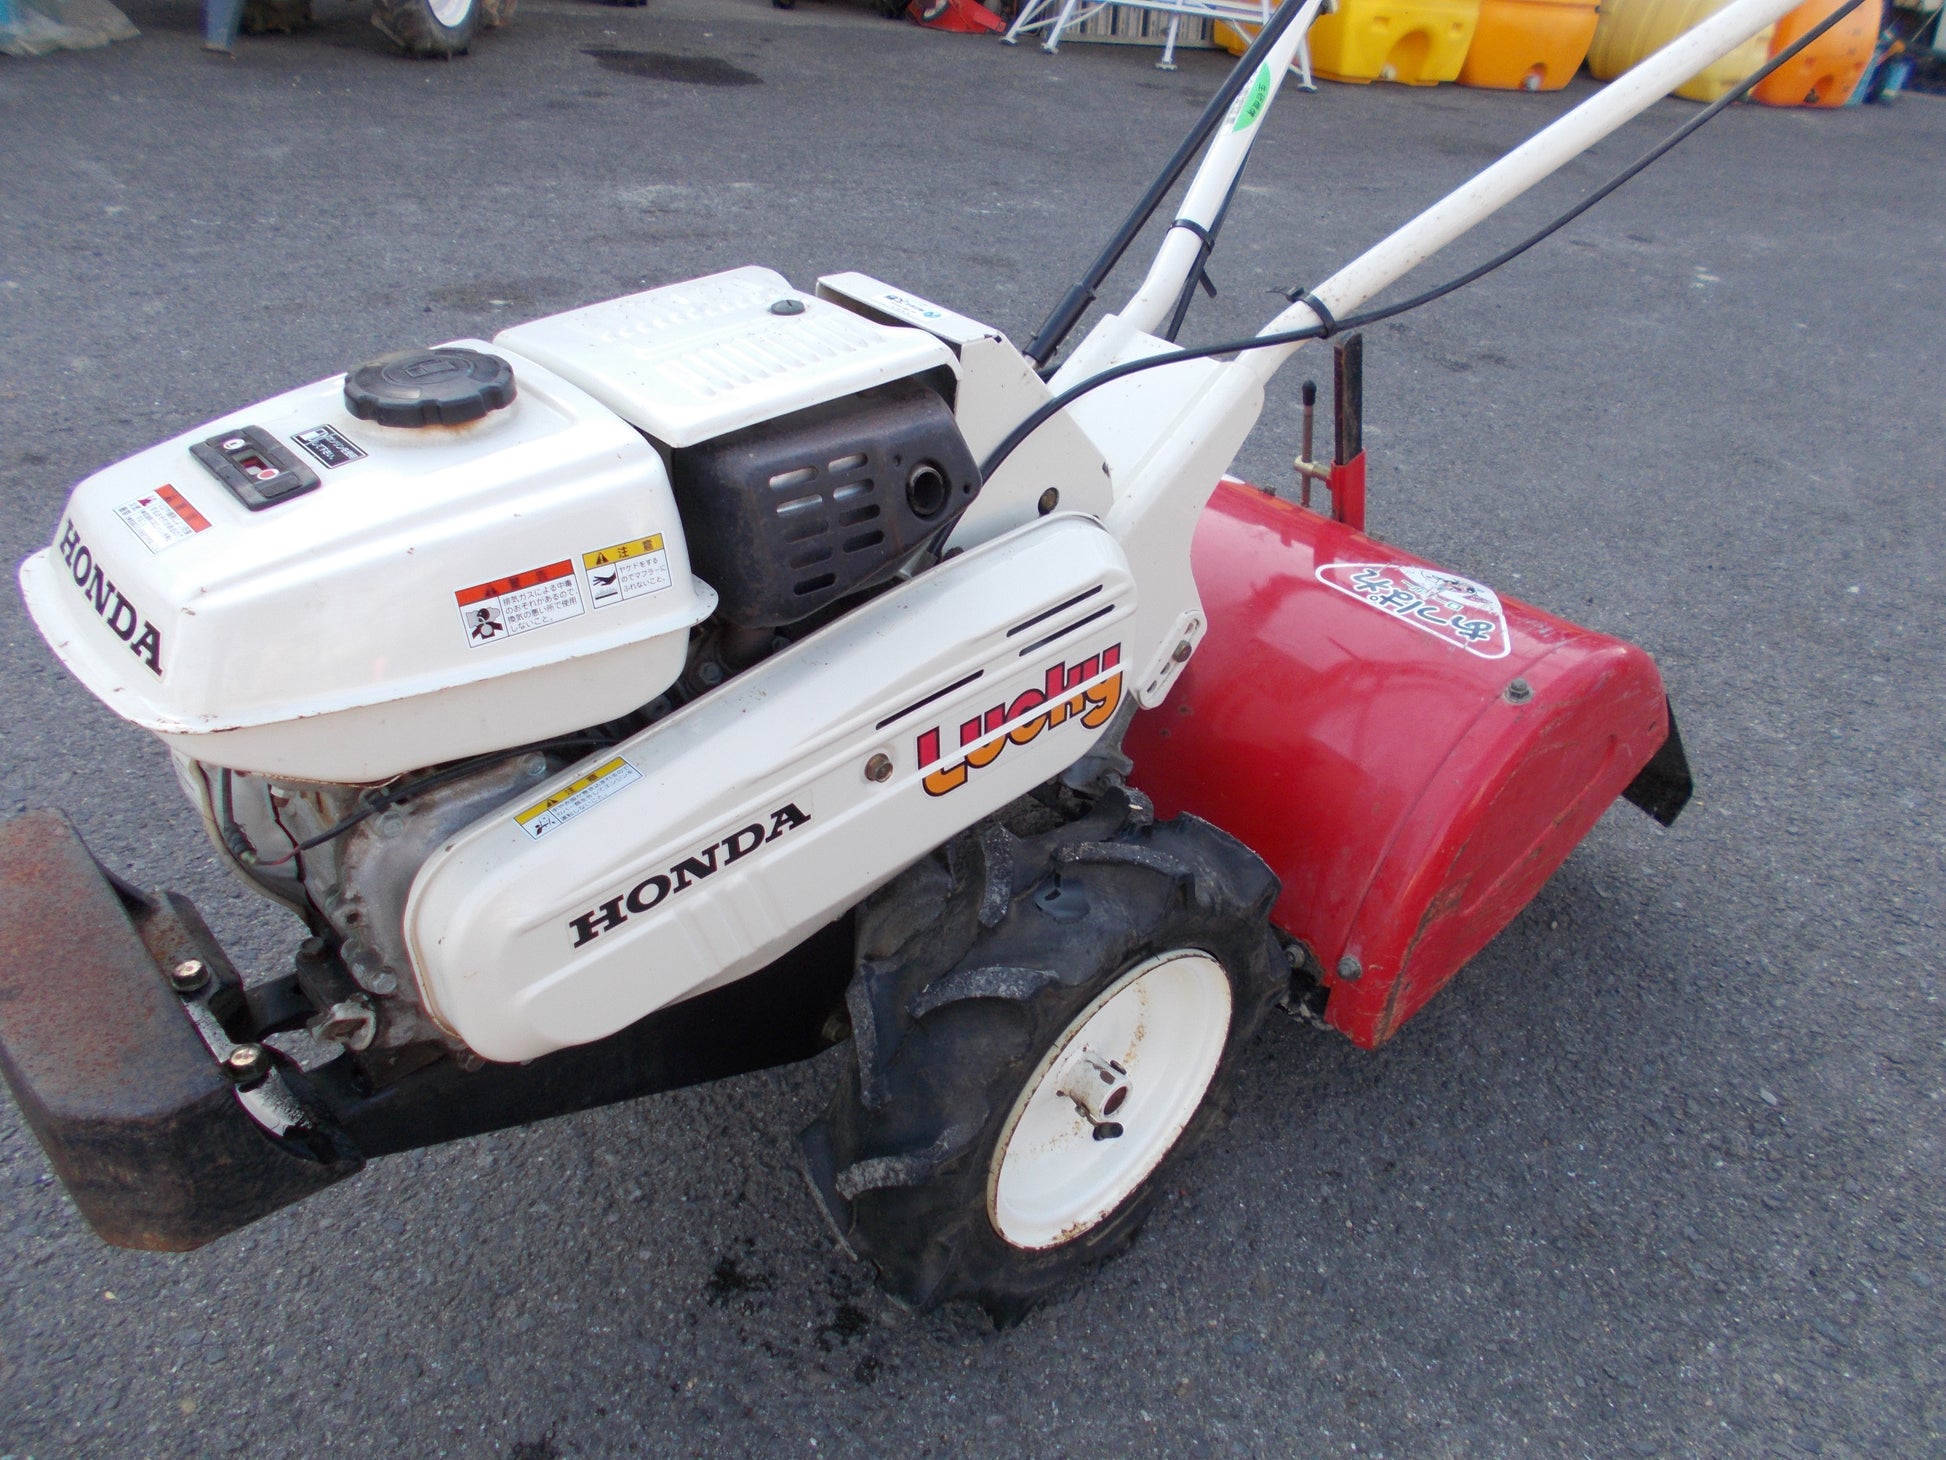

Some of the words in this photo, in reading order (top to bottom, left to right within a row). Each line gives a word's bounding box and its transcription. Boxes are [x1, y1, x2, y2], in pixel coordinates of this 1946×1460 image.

[617, 539, 654, 558] 注意
[619, 557, 658, 573] ヤケドをする
[621, 565, 666, 583] のでマフラーに
[59, 518, 163, 676] HONDA
[503, 579, 573, 606] 排気ガスによる中毒
[624, 576, 665, 592] ふれないこと。
[508, 596, 578, 624] 換気の悪い所で使用
[1351, 568, 1495, 641] あっぱれ
[511, 616, 554, 632] しないこと。
[917, 642, 1124, 797] Lucky
[571, 804, 811, 946] HONDA
